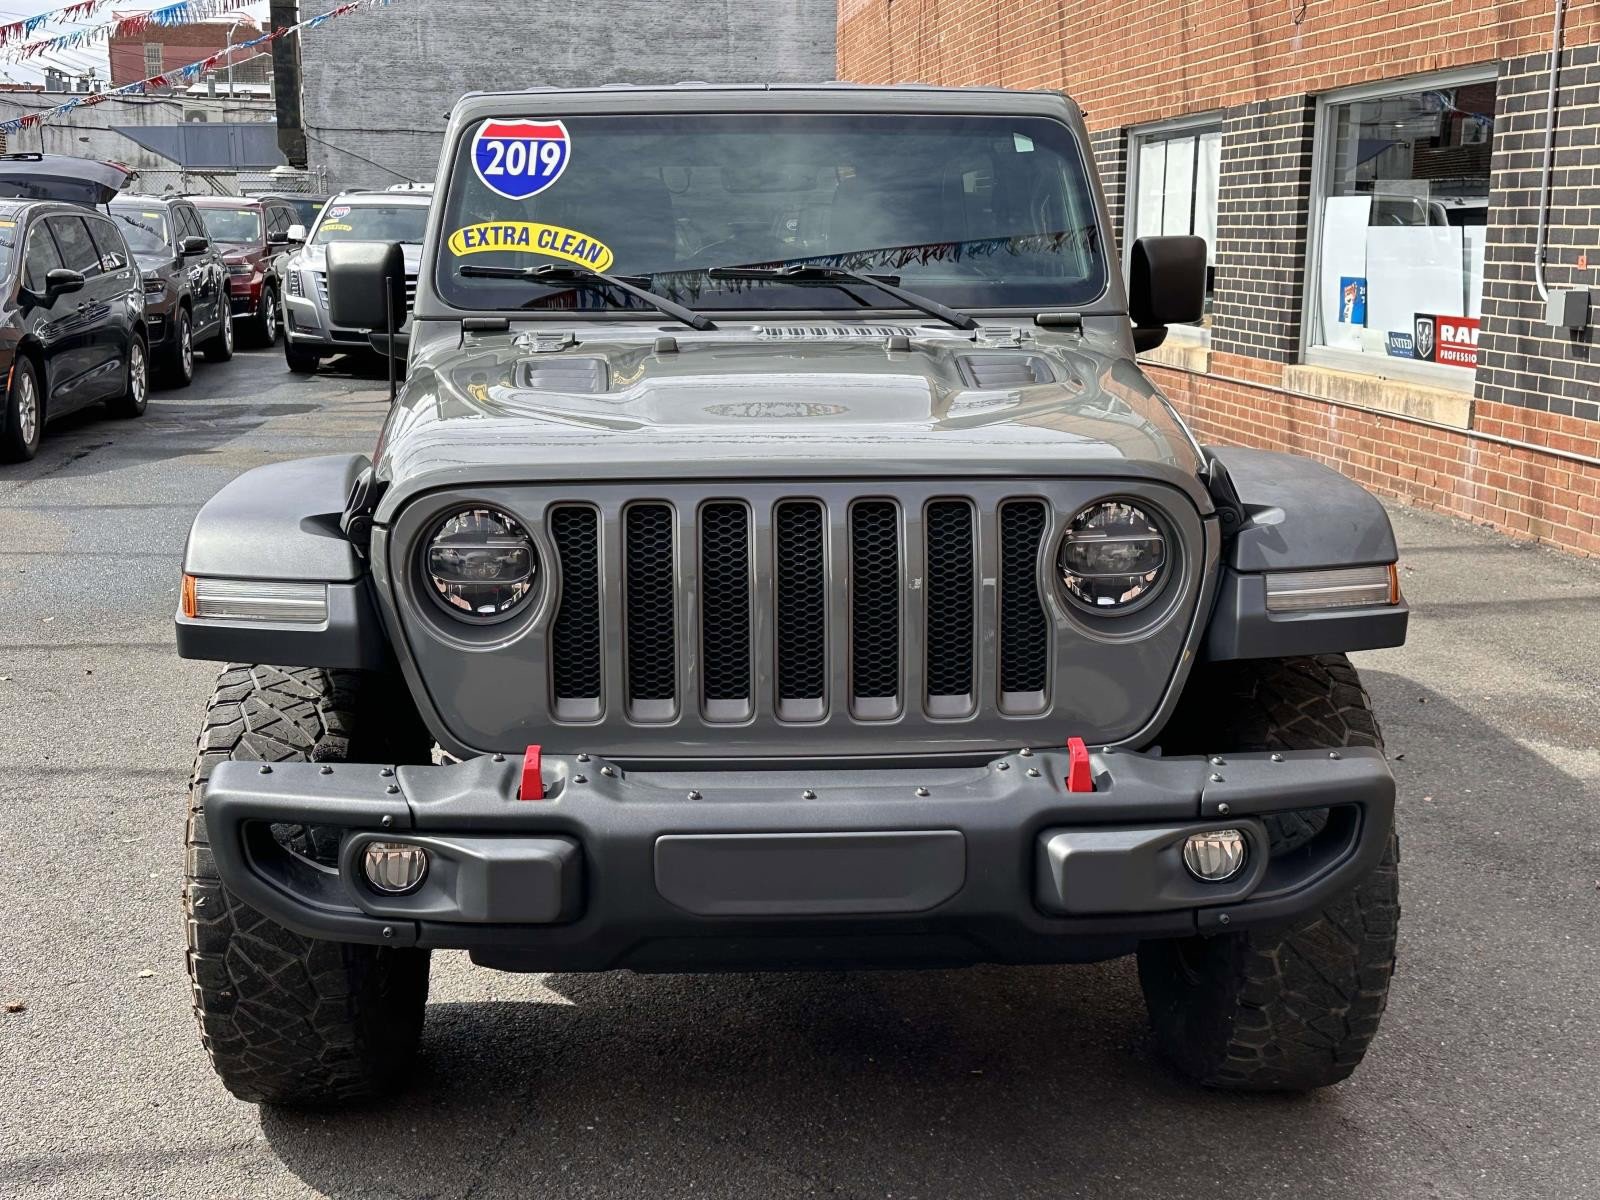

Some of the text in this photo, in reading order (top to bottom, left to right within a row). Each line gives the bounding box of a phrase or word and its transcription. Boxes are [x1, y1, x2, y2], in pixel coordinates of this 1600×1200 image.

[484, 140, 561, 177] 2019
[463, 226, 604, 264] EXTRA CLEAN
[1390, 337, 1413, 350] UNITED
[1440, 349, 1477, 364] PROFESSIO
